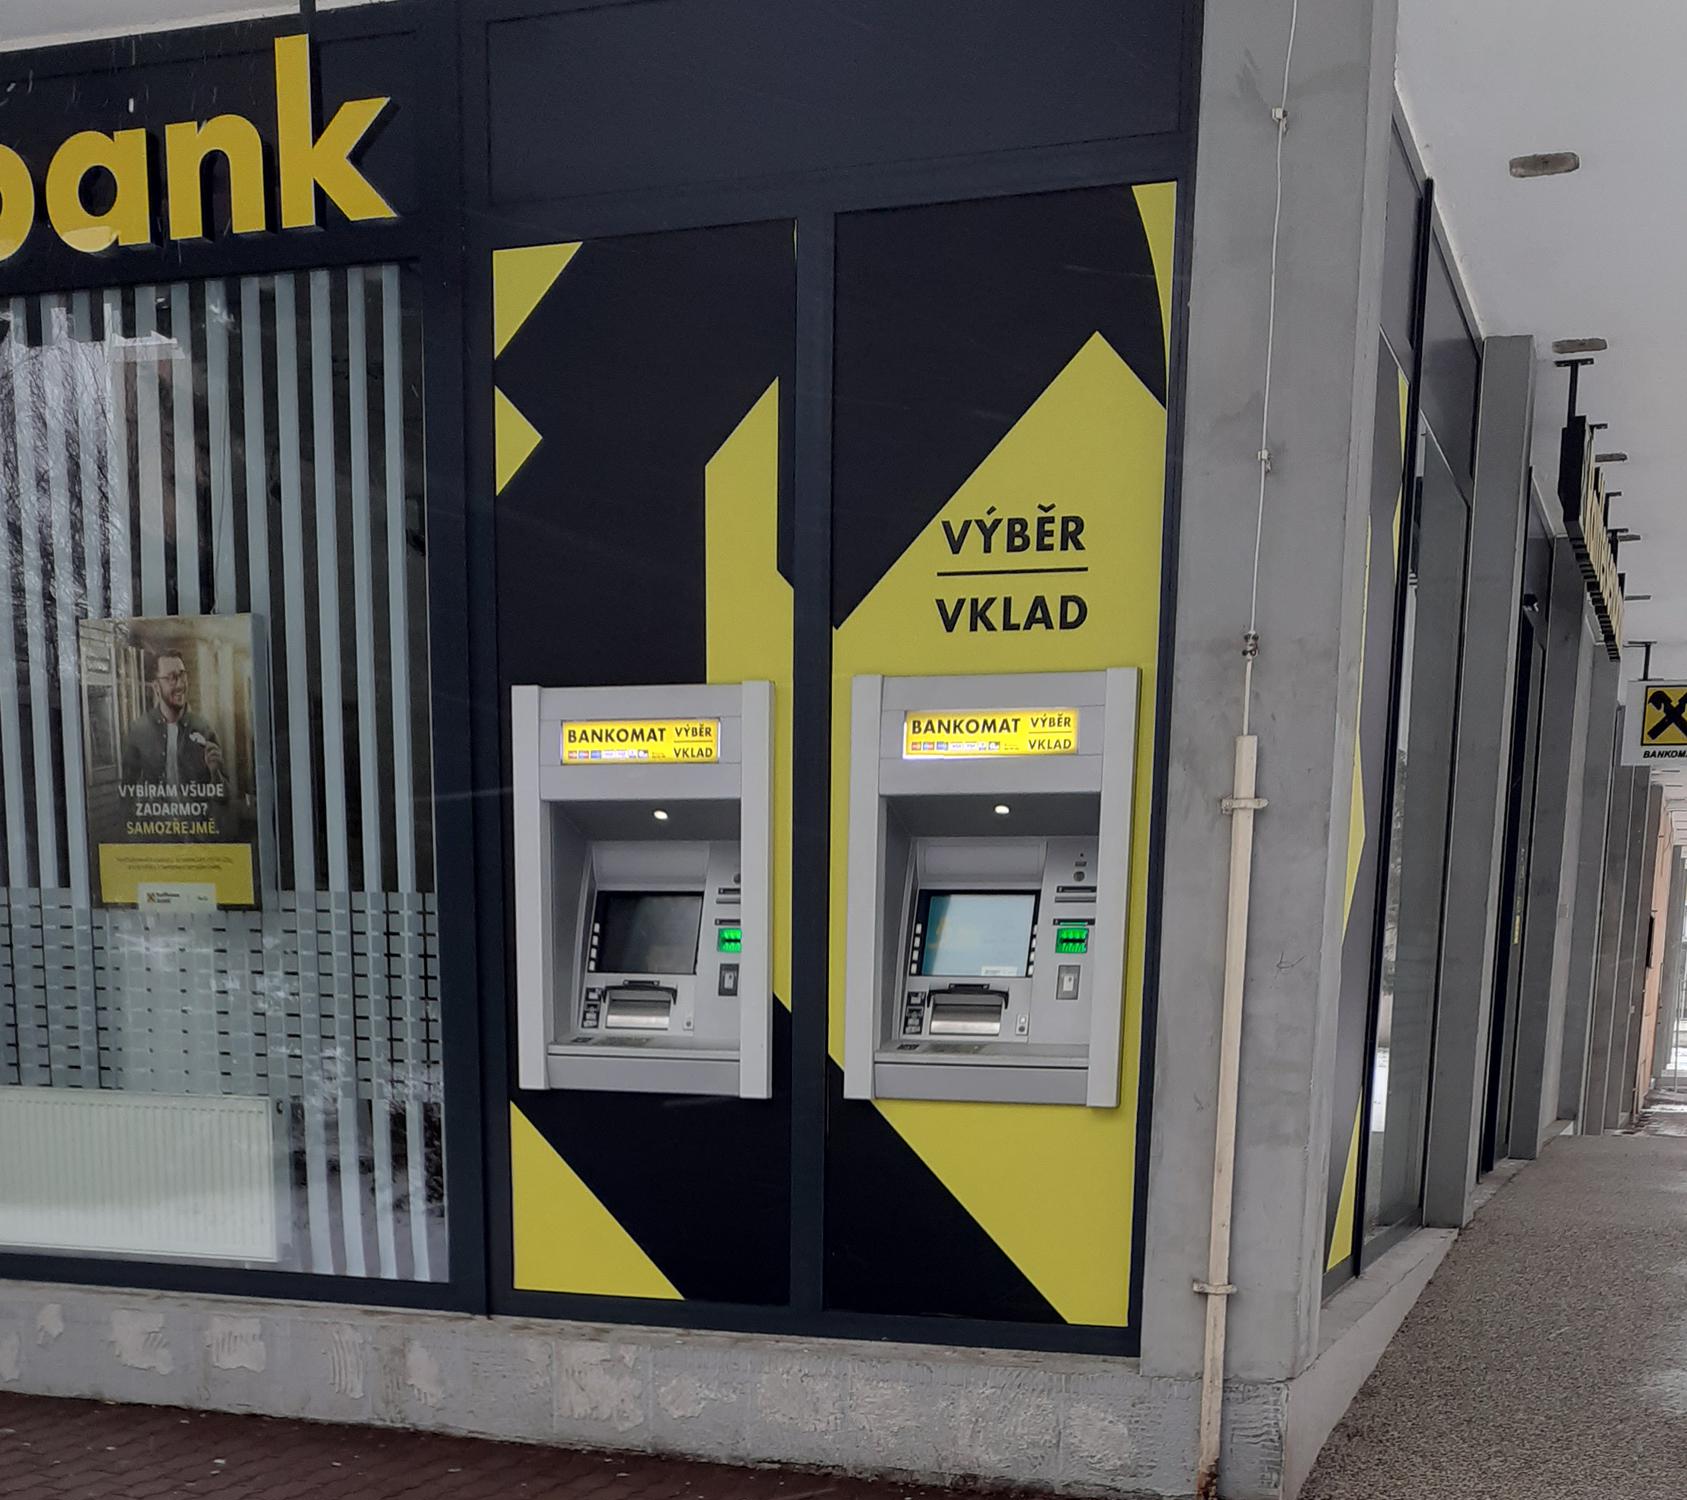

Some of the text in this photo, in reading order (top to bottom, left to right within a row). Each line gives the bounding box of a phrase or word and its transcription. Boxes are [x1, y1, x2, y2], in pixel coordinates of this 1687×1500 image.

[941, 503, 1086, 554] VÝBĚR
[935, 595, 1088, 633] VKLAD
[911, 718, 1021, 735] BANKOMAT
[1030, 714, 1072, 728] VÝBĚR
[567, 728, 666, 743] BANKOMAT
[674, 724, 712, 738] VÝBĚR
[1029, 739, 1072, 750] VKLAD
[673, 747, 713, 758] VKLAD
[1643, 750, 1687, 758] BANKOM
[118, 781, 225, 798] VYBÍRÁM VŠUDE
[135, 802, 208, 816] ZADARMO?
[126, 818, 220, 835] SAMOZŘEJMĚ.
